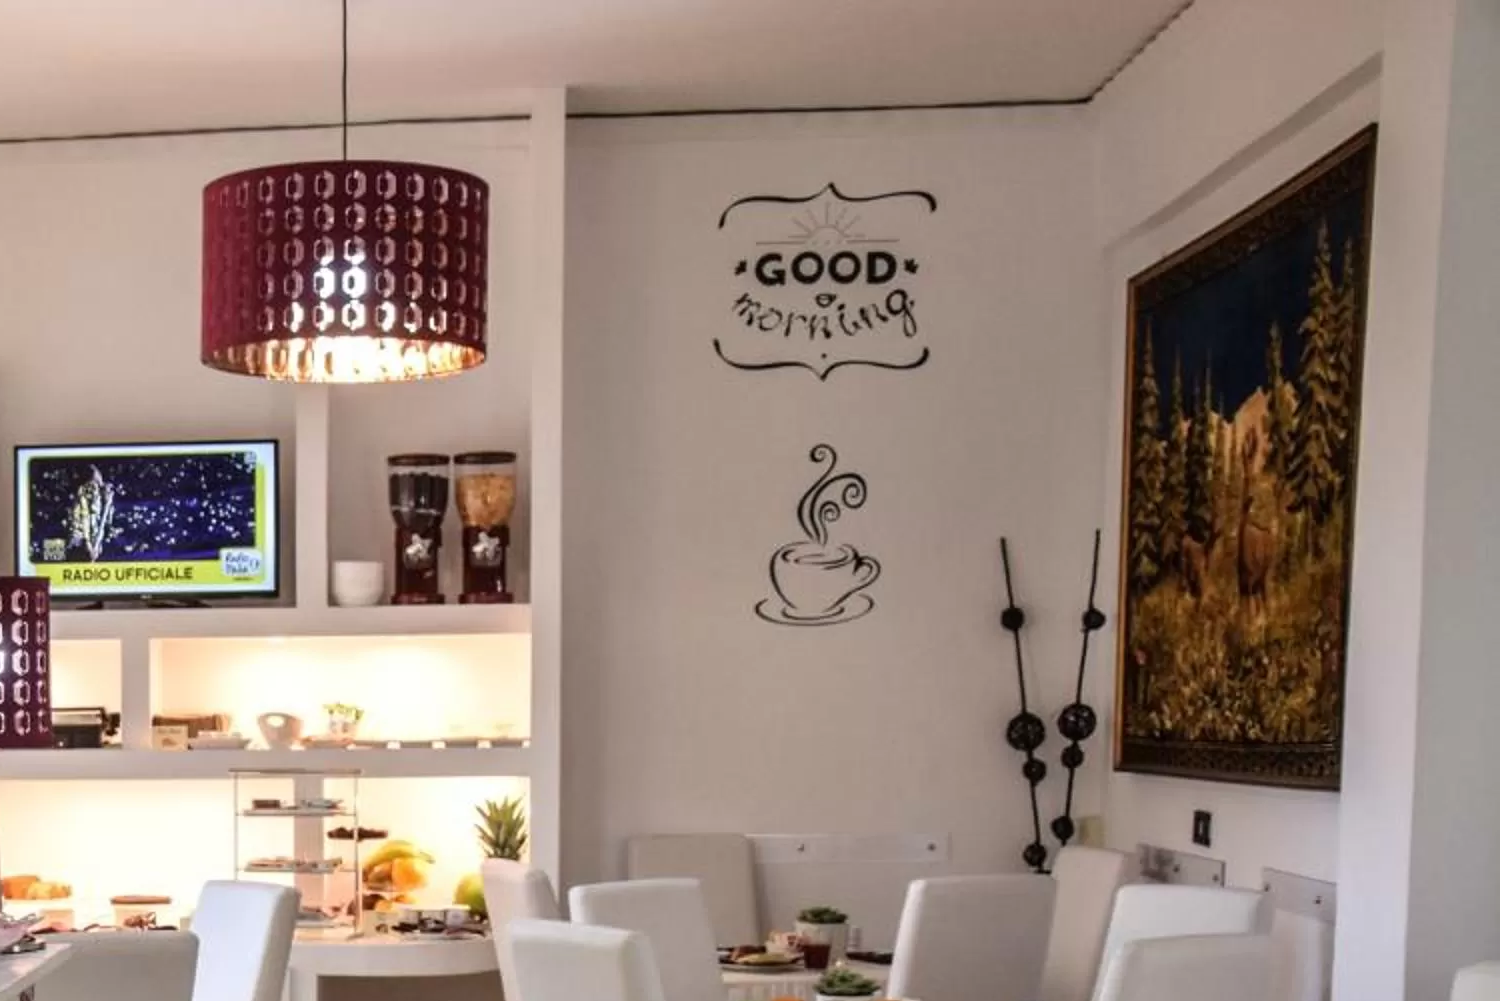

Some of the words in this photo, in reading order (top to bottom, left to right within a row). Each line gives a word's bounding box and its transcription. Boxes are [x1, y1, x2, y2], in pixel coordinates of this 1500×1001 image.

[754, 250, 898, 287] GOOD
[62, 567, 111, 582] RADIO
[115, 565, 194, 581] UFFICIALE
